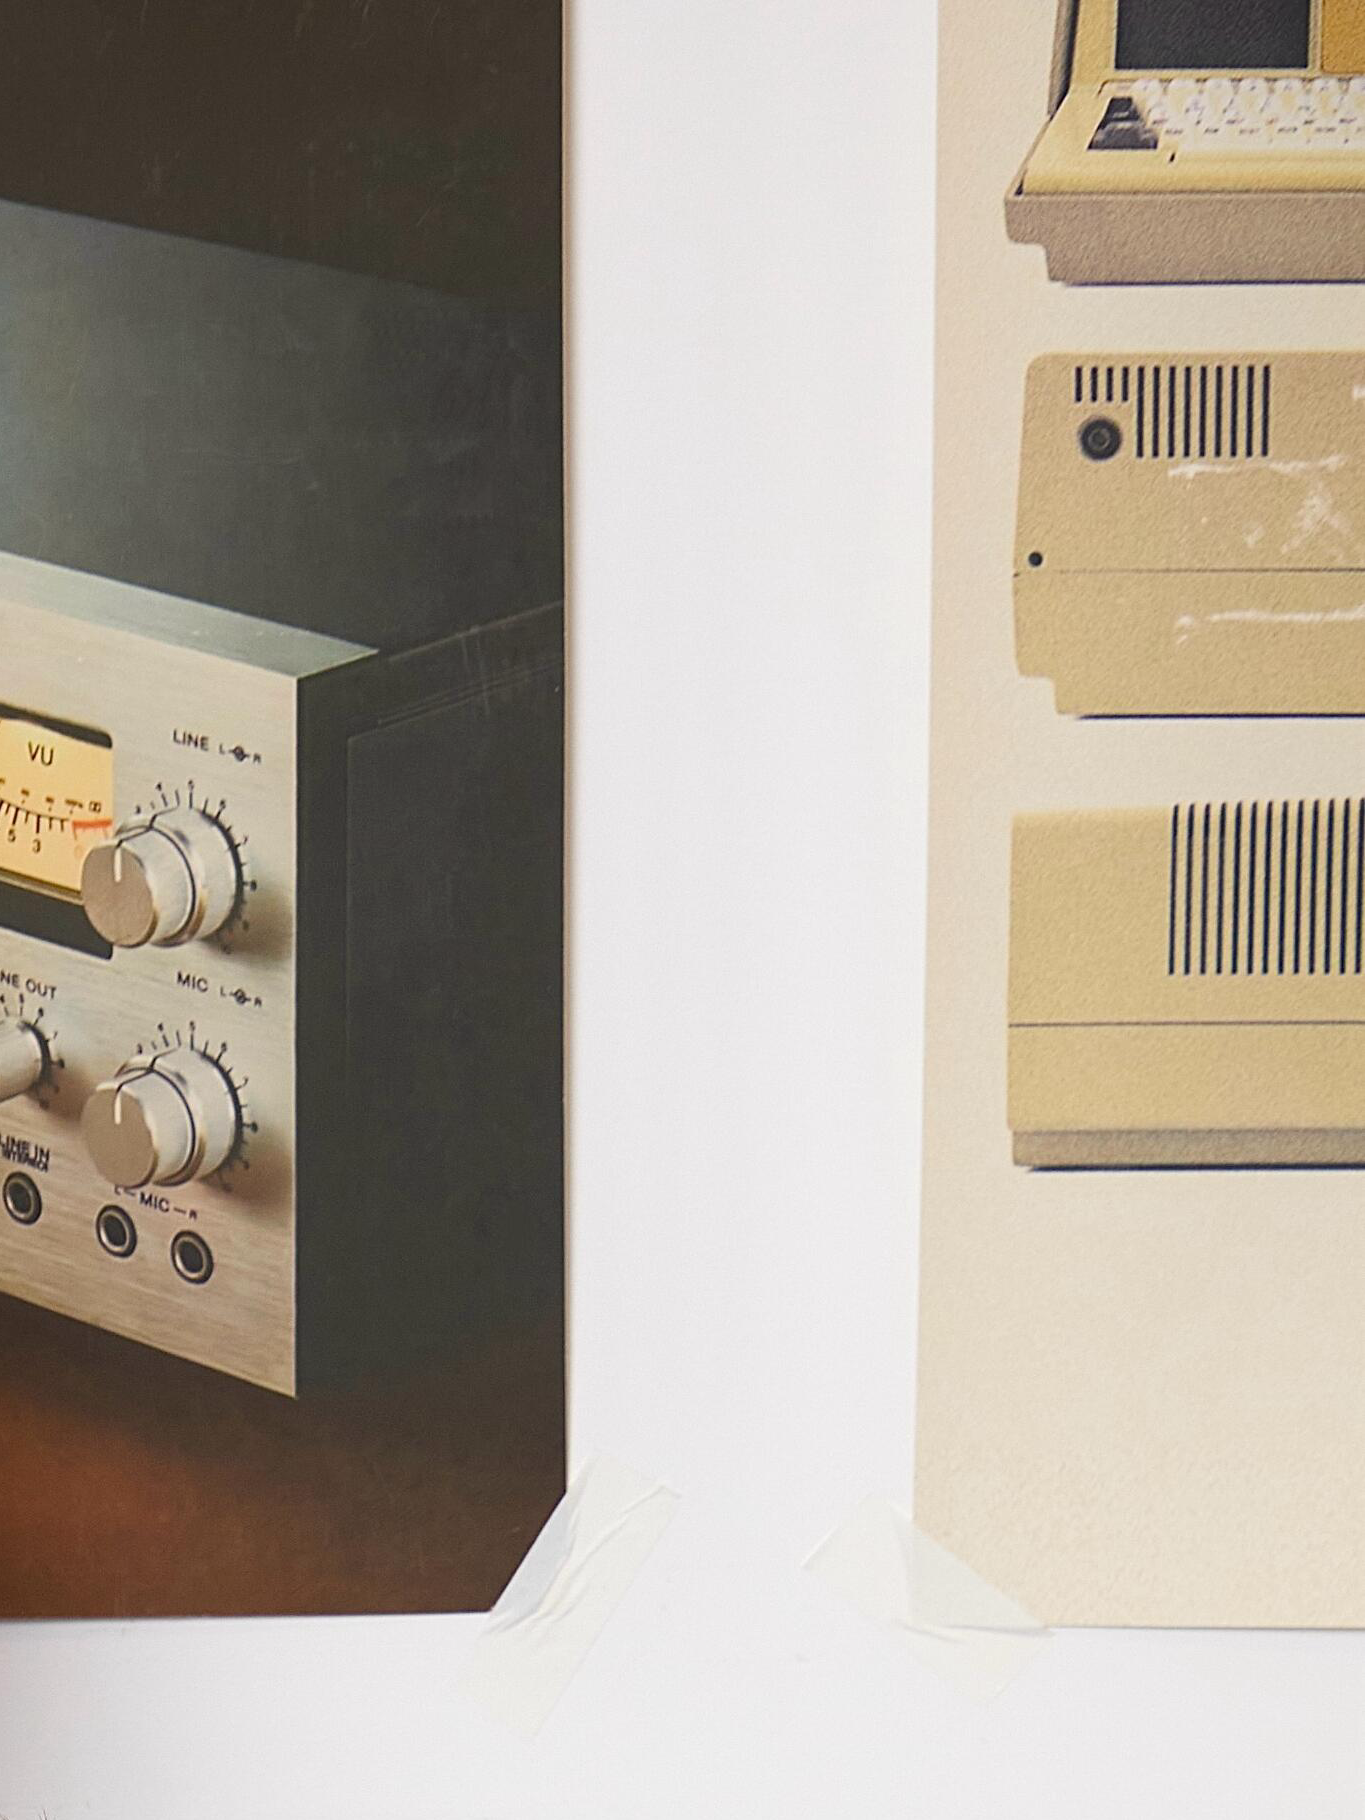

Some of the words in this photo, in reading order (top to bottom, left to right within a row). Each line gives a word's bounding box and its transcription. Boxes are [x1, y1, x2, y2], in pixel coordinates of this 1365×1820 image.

[173, 729, 209, 751] LINE
[28, 741, 55, 766] VU
[25, 978, 57, 1000] OUT
[176, 971, 208, 993] MIC
[139, 1192, 170, 1213] MIC
